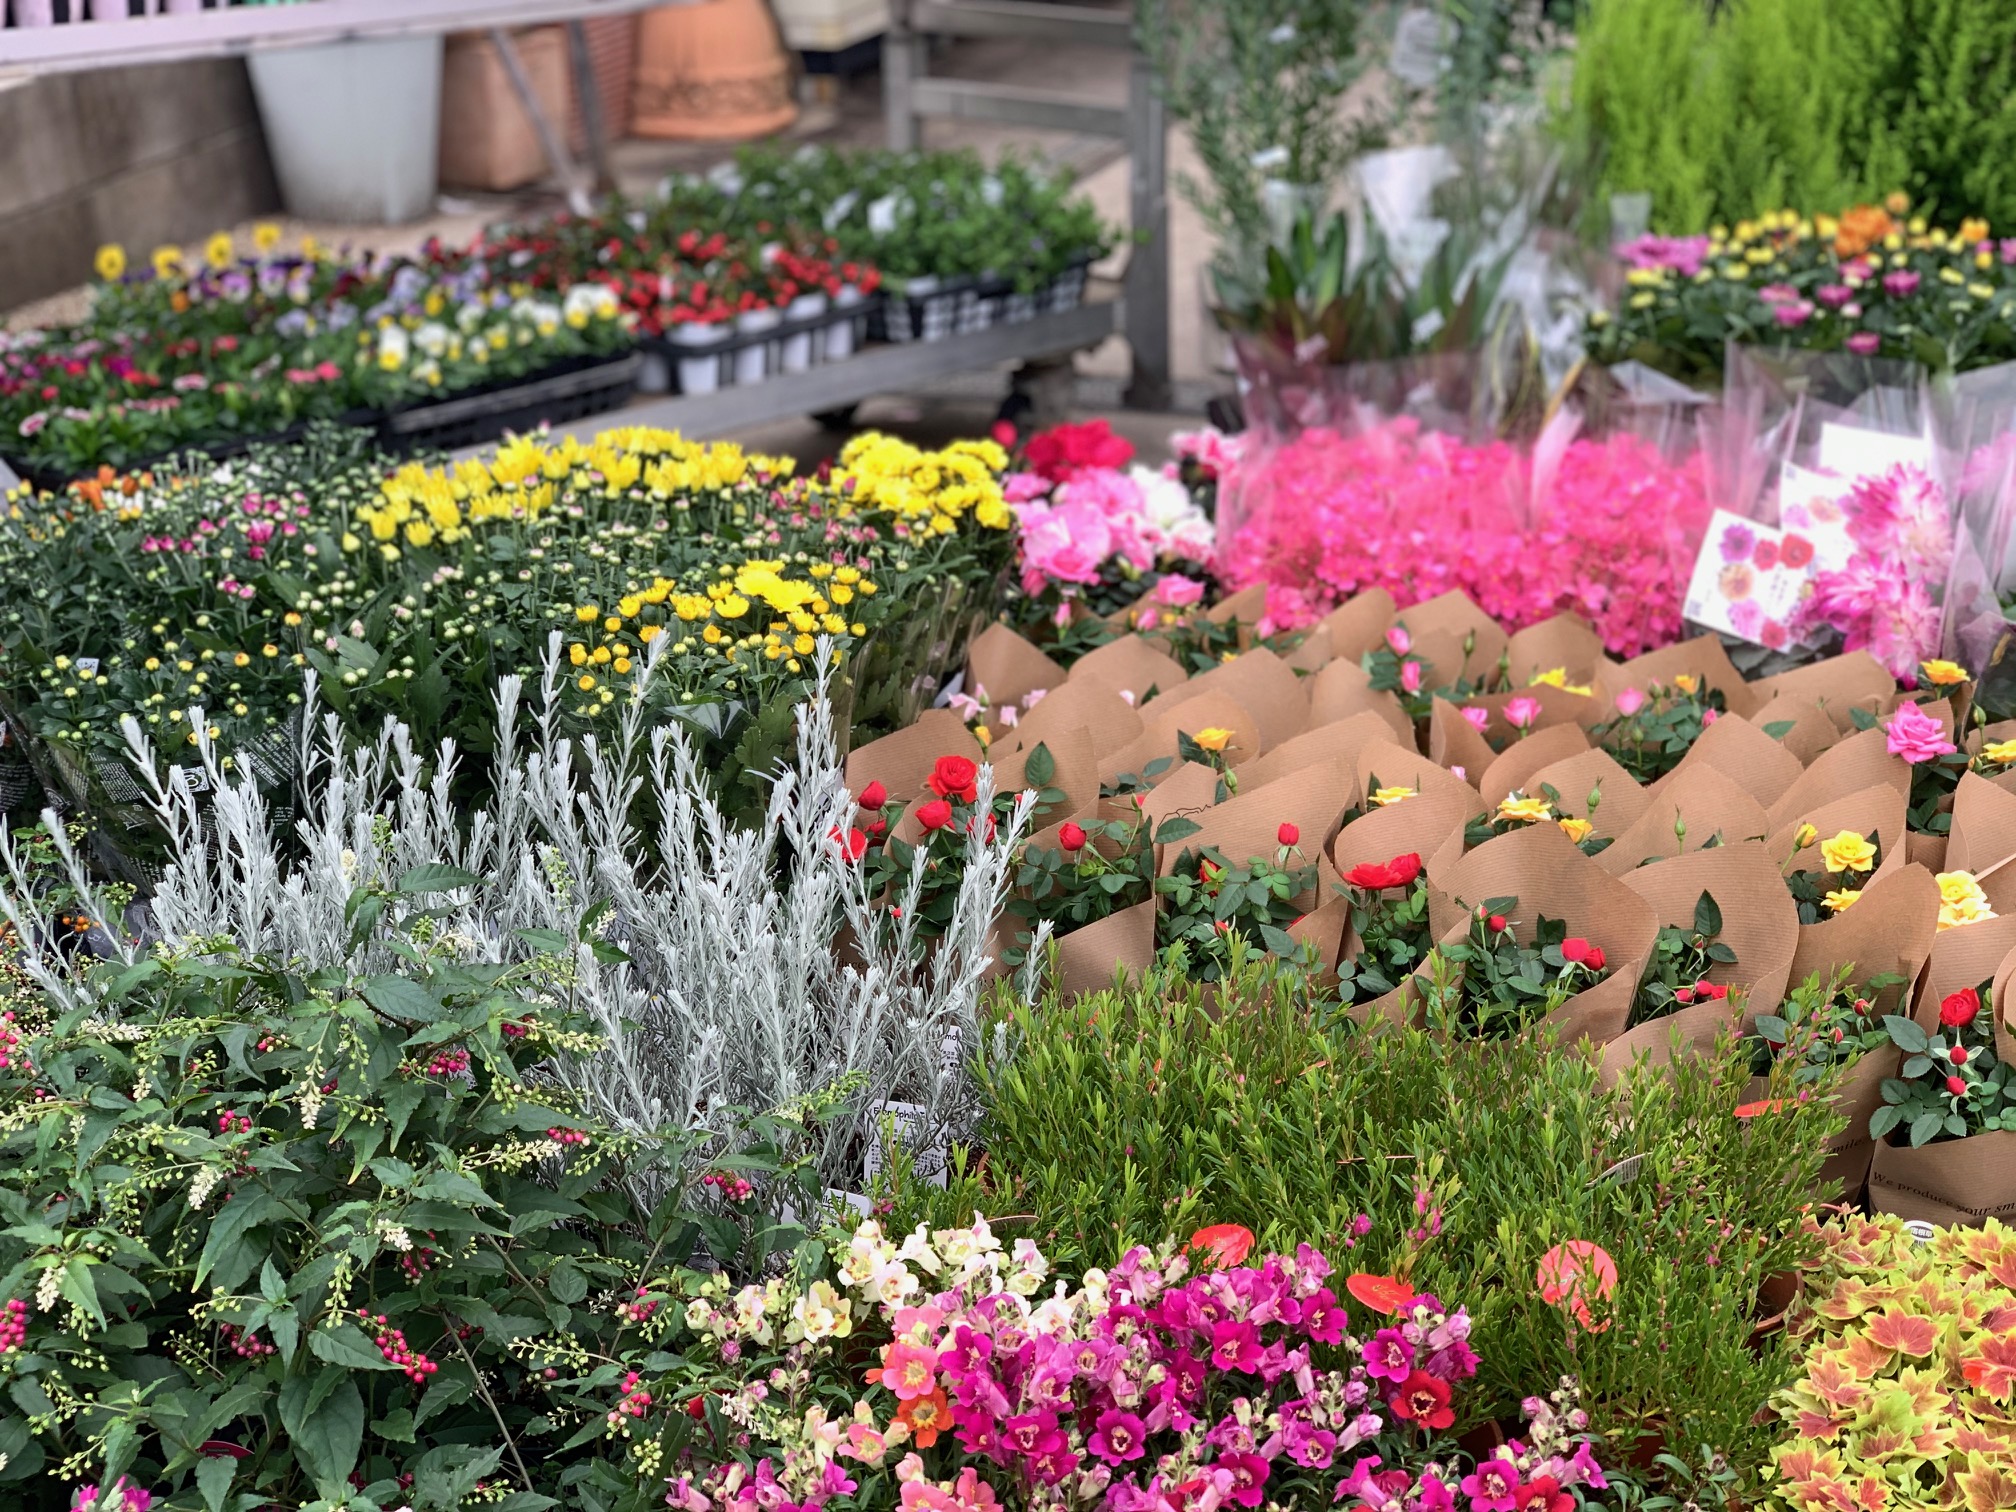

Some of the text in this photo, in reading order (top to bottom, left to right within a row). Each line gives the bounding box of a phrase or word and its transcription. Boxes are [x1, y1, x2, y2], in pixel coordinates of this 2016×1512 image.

[1873, 1171, 1894, 1186] We
[1897, 1182, 1953, 1206] produce
[1955, 1204, 1991, 1216] your
